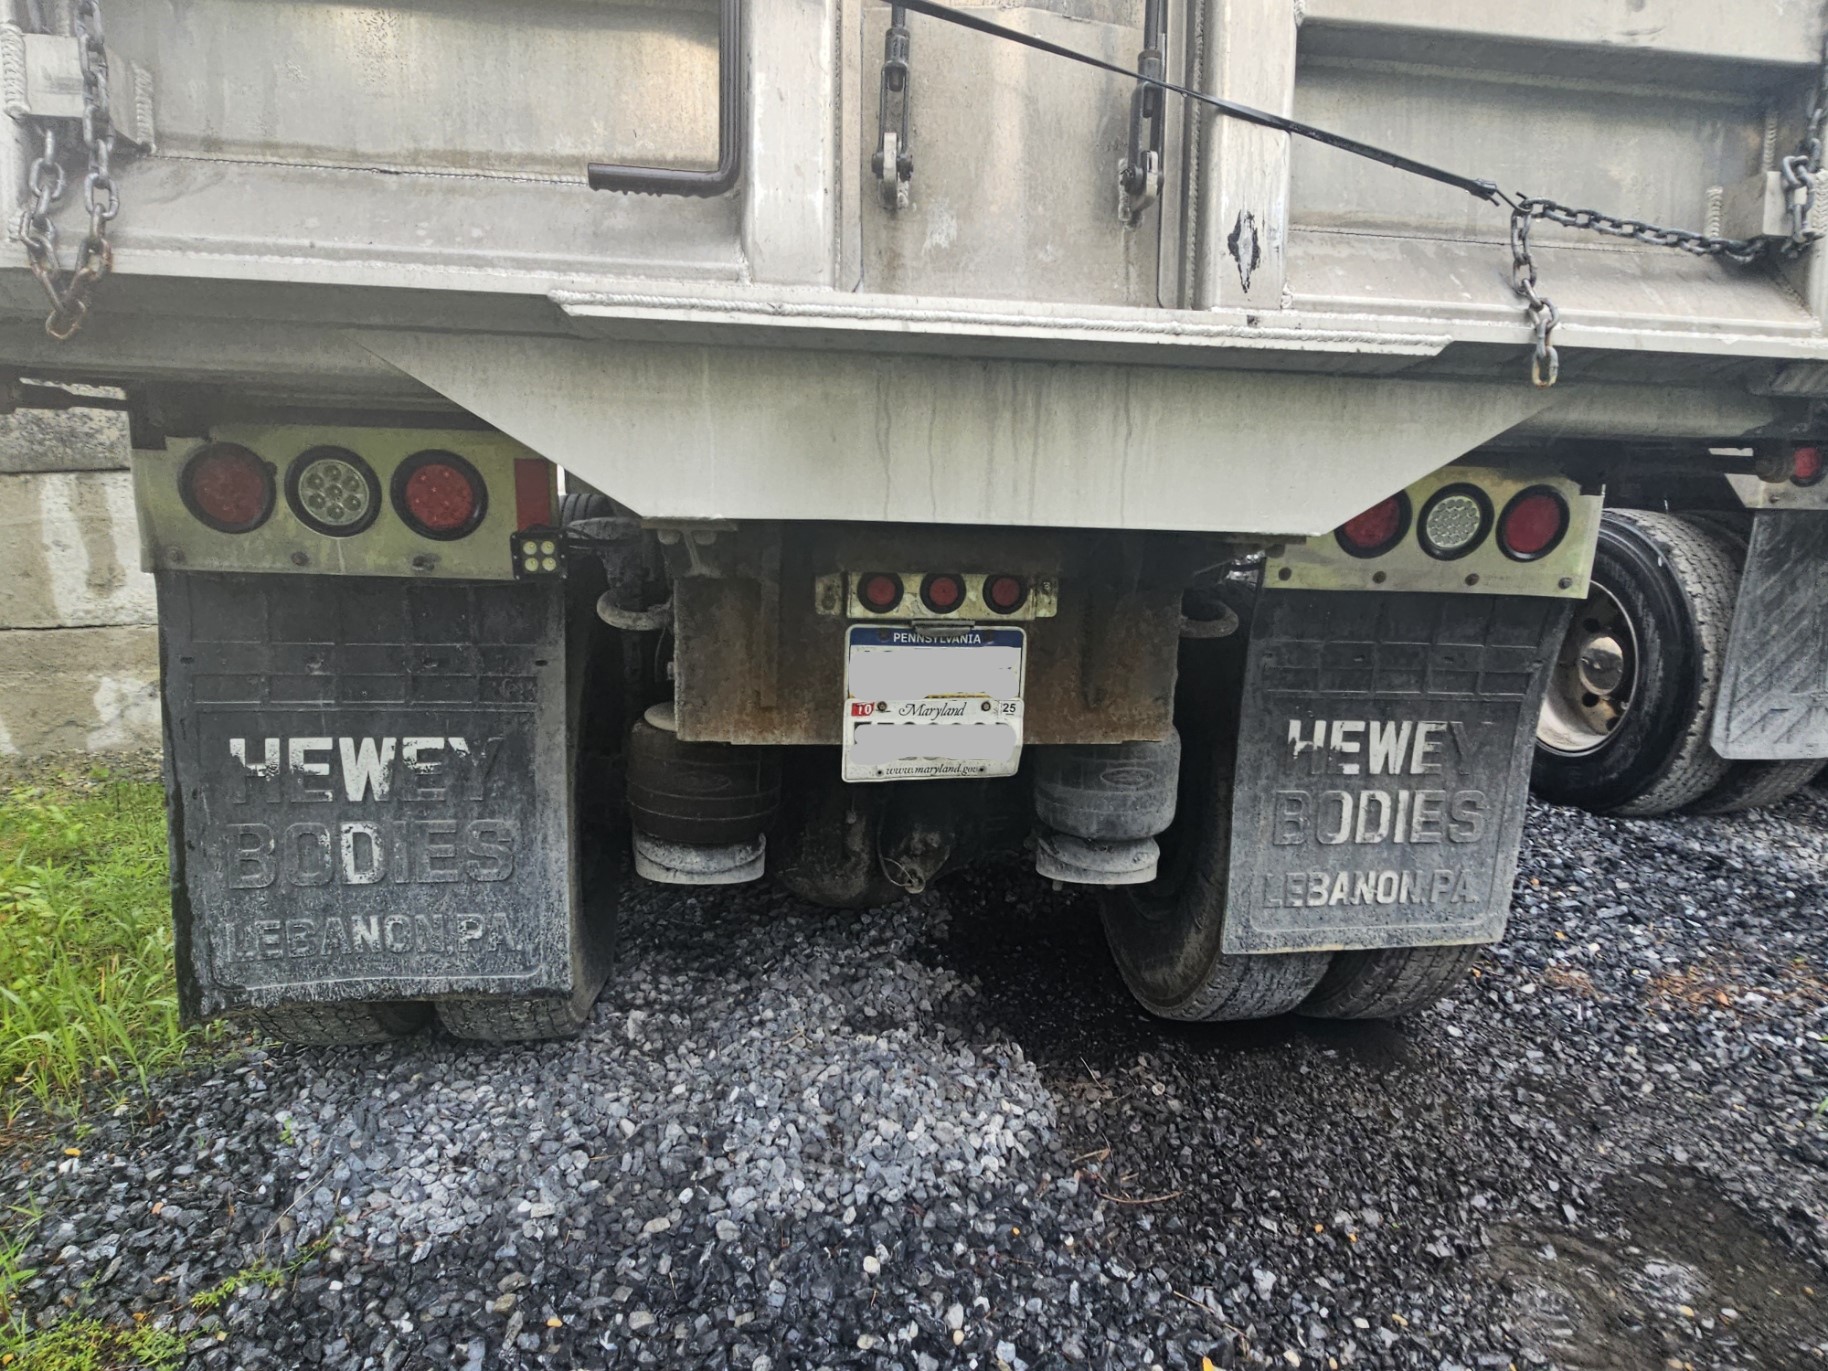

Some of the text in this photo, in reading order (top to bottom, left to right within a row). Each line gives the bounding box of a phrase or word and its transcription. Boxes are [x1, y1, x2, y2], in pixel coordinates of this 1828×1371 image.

[893, 632, 982, 644] PENNSYLVANIA
[857, 702, 1016, 720] 10 Maryland 25
[229, 736, 504, 802] HEWEY
[886, 764, 979, 778] www.maryland.gov
[1287, 719, 1495, 776] HEWEY
[1272, 789, 1488, 845] BODIES
[227, 818, 514, 889] BODIES
